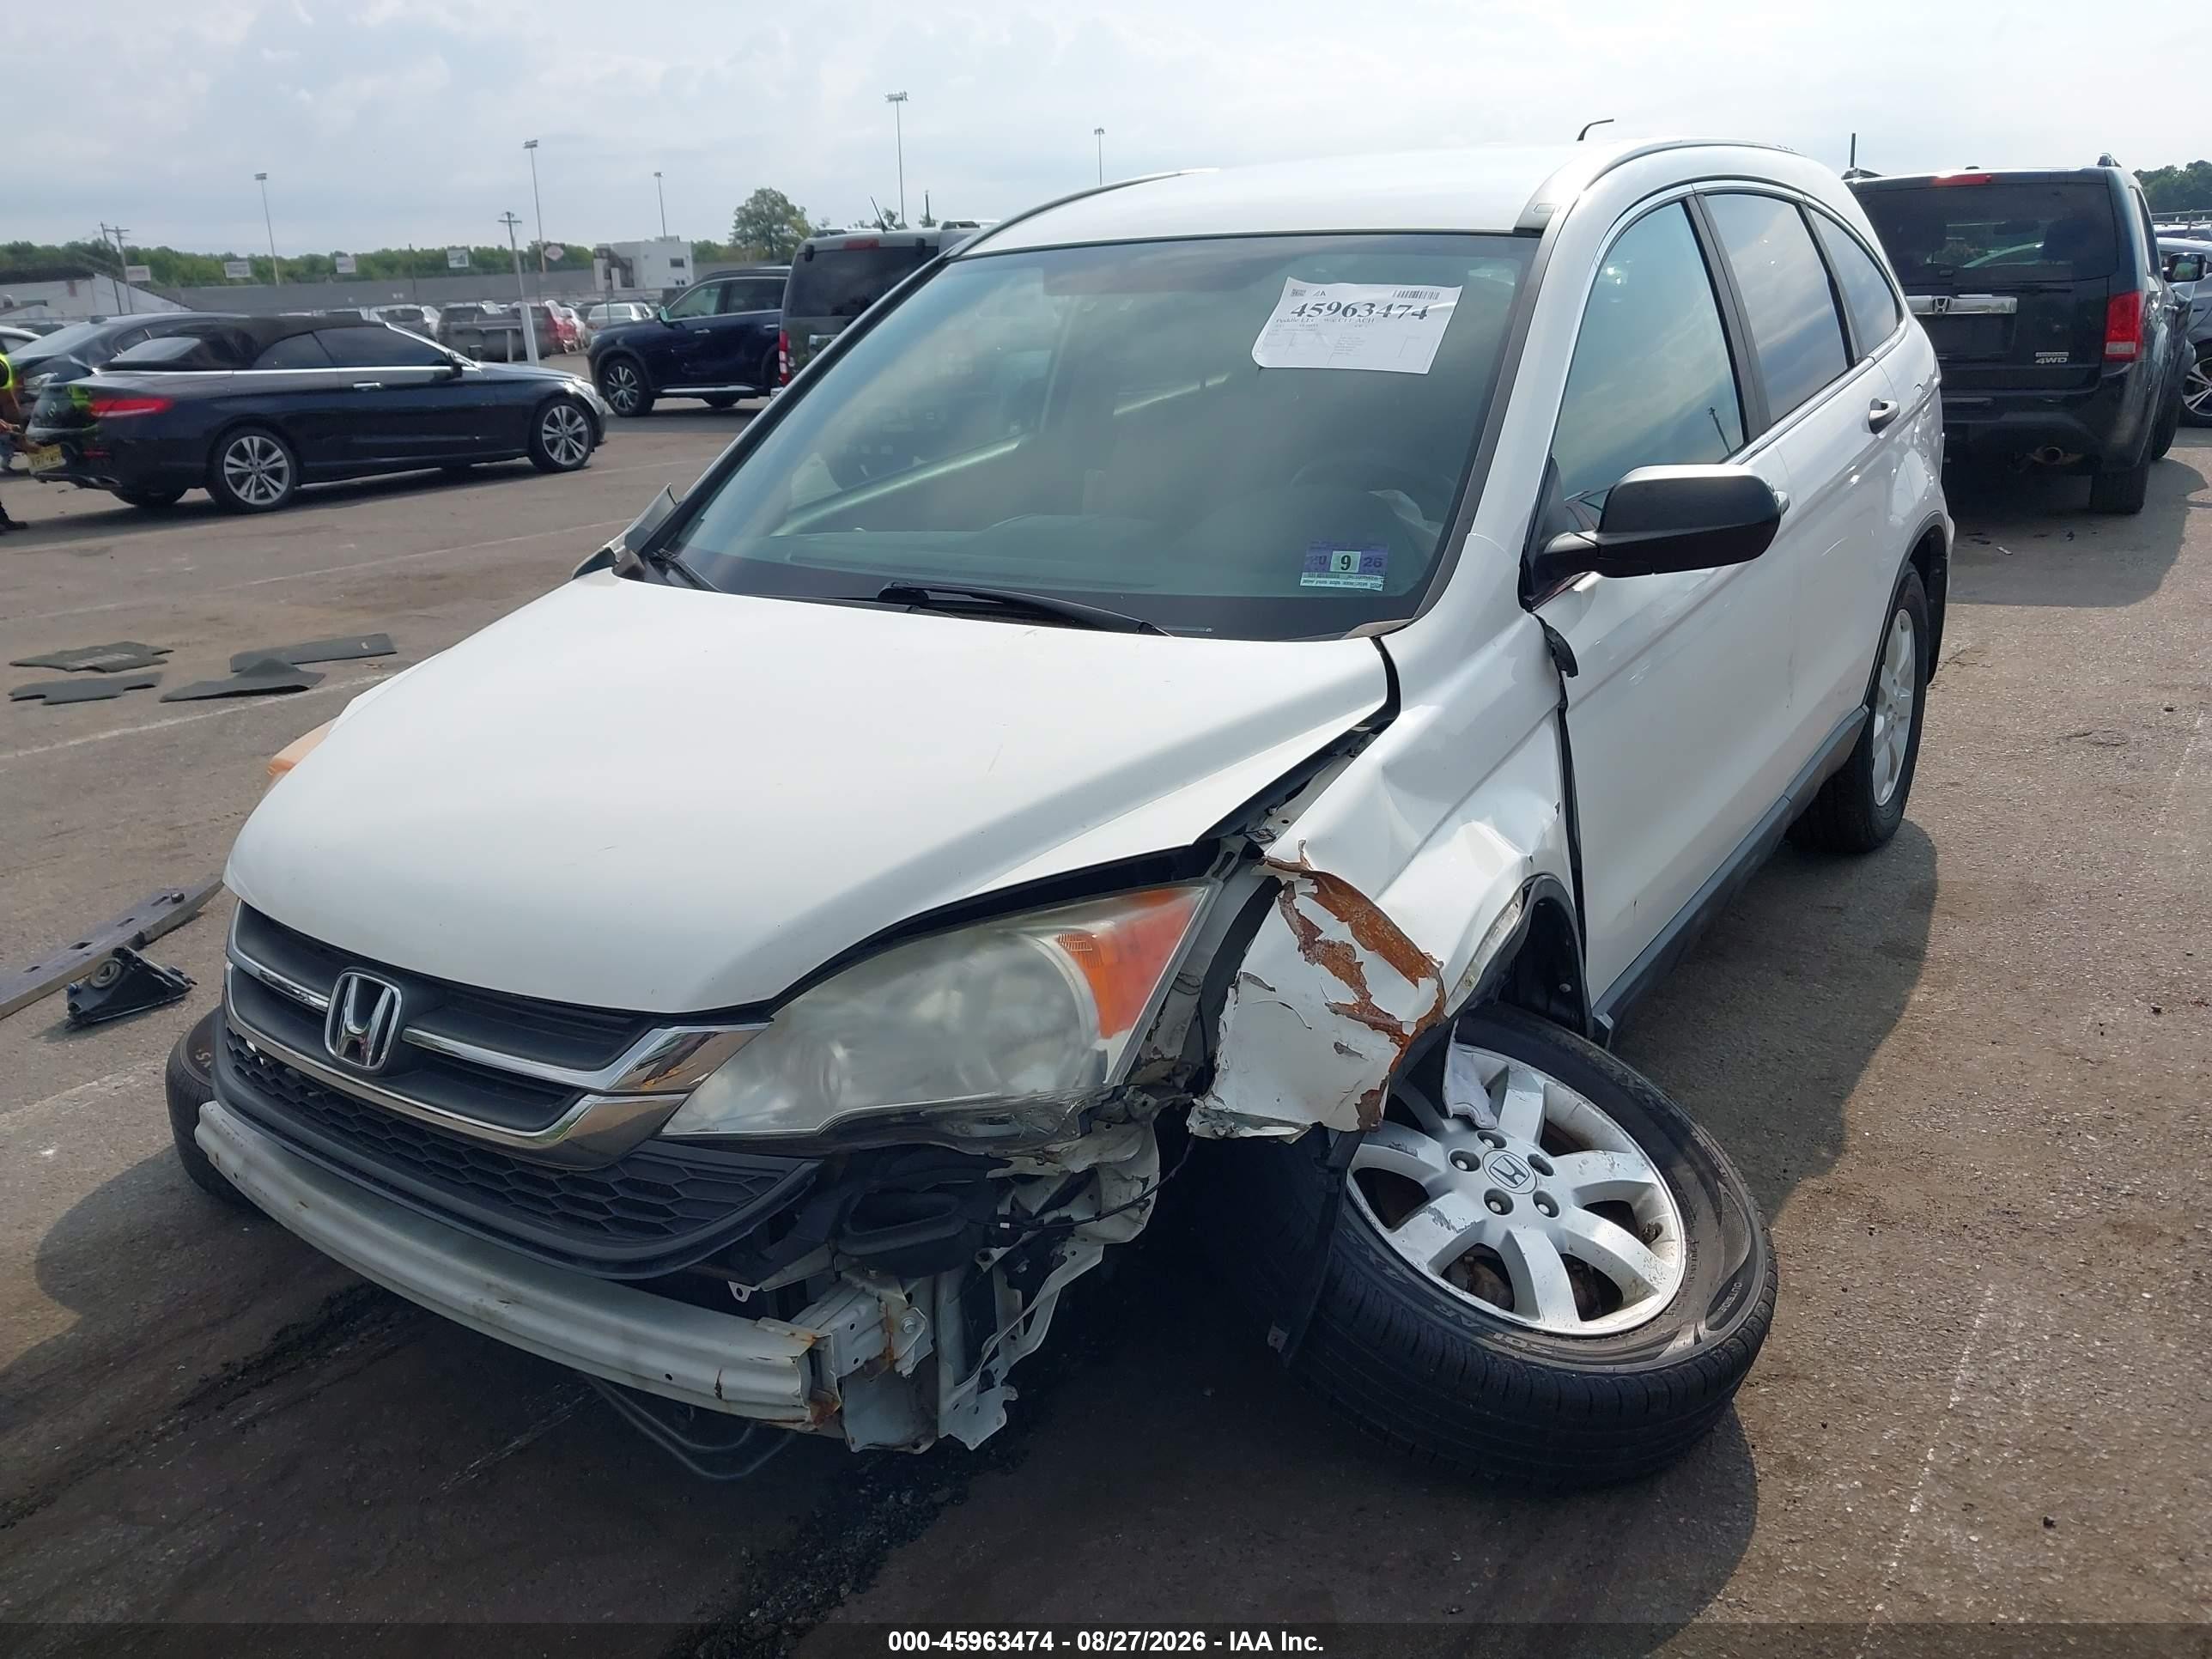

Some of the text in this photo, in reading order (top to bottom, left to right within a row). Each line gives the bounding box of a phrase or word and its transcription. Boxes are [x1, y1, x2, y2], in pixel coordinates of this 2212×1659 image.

[1291, 301, 1429, 320] 45963474
[1340, 555, 1351, 570] 9
[1363, 556, 1383, 568] 26
[1717, 1281, 1743, 1314] OUTSIDE
